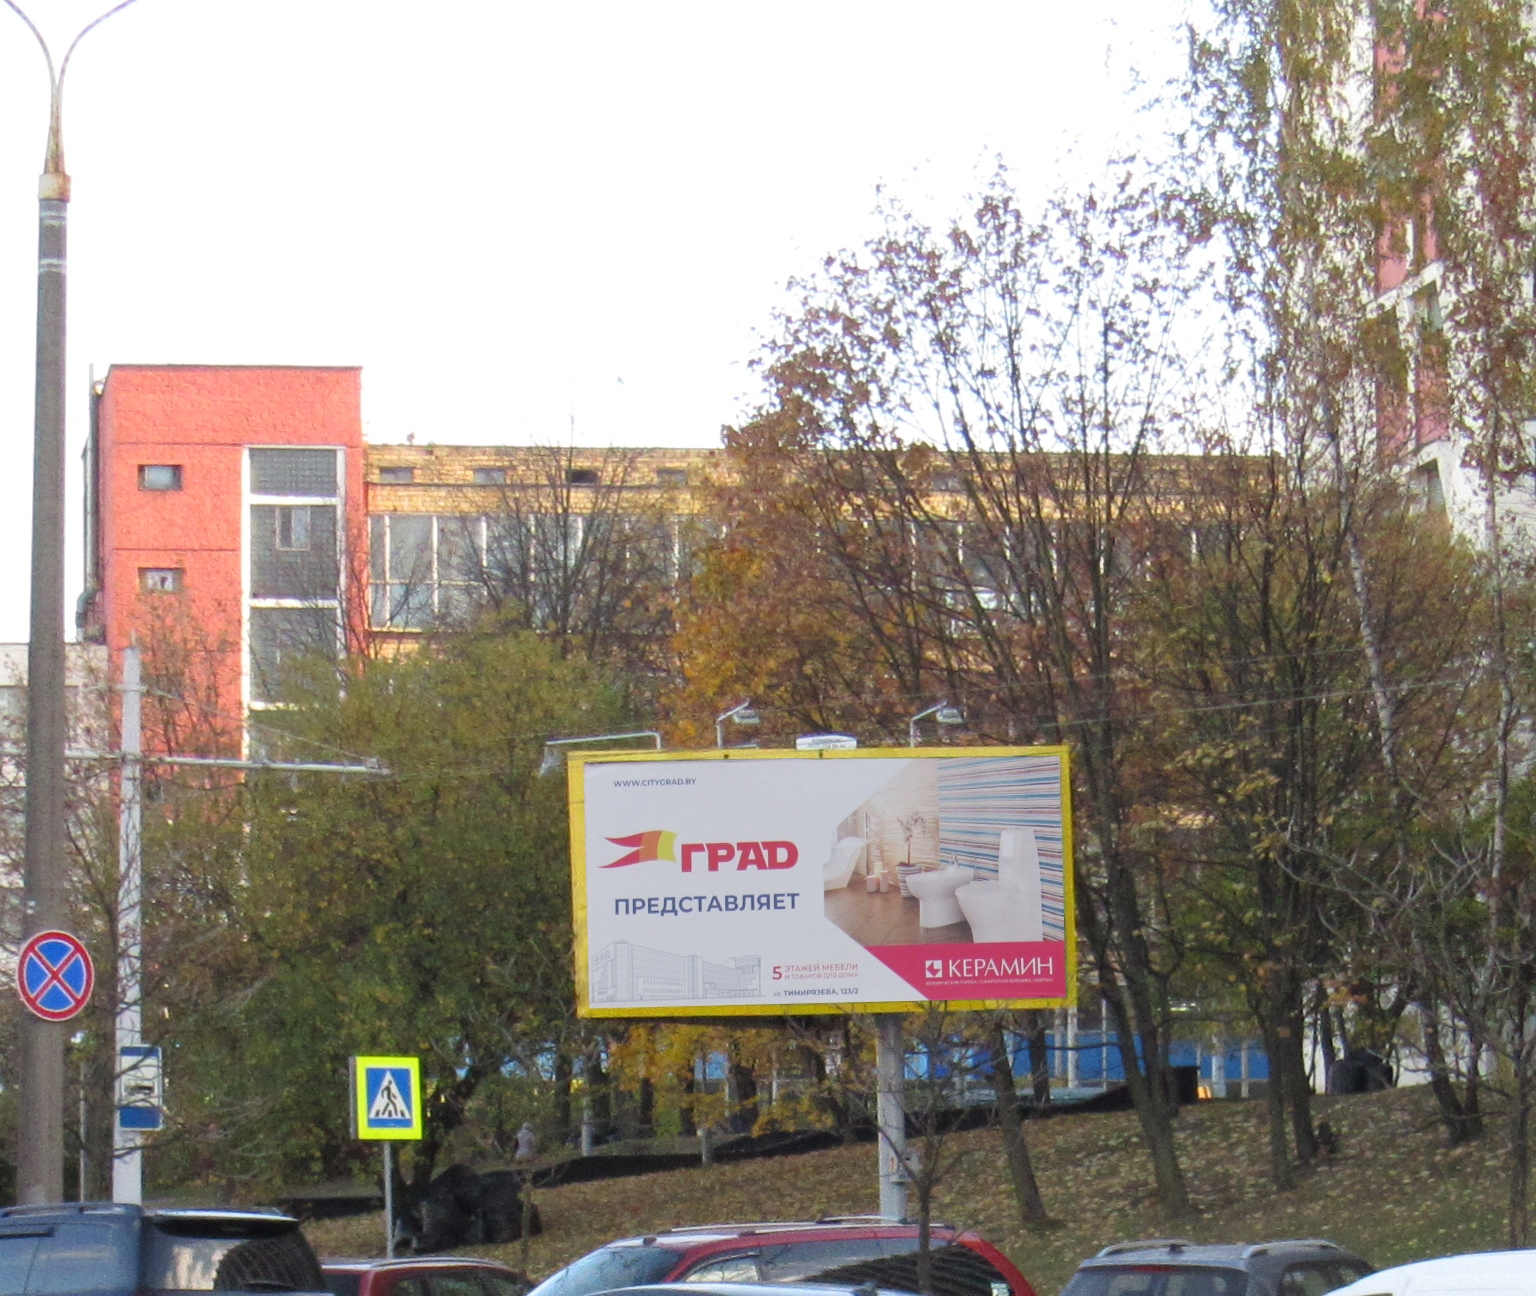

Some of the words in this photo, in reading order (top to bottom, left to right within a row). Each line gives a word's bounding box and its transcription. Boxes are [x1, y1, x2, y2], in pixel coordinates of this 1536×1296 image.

[613, 777, 697, 787] WWW.CITYGRAD.BY
[680, 840, 799, 873] ГРАД
[614, 892, 800, 917] ПРЕДСТАВЛЯЕТ
[772, 965, 783, 981] 5
[784, 964, 820, 973] ЭТАЖЕЙ
[822, 963, 859, 972] МЕБЕЛИ
[948, 956, 1053, 978] КЕРАМИН
[783, 989, 839, 997] ТИМИРЯЗЕВА,
[840, 987, 859, 995] 123/2
